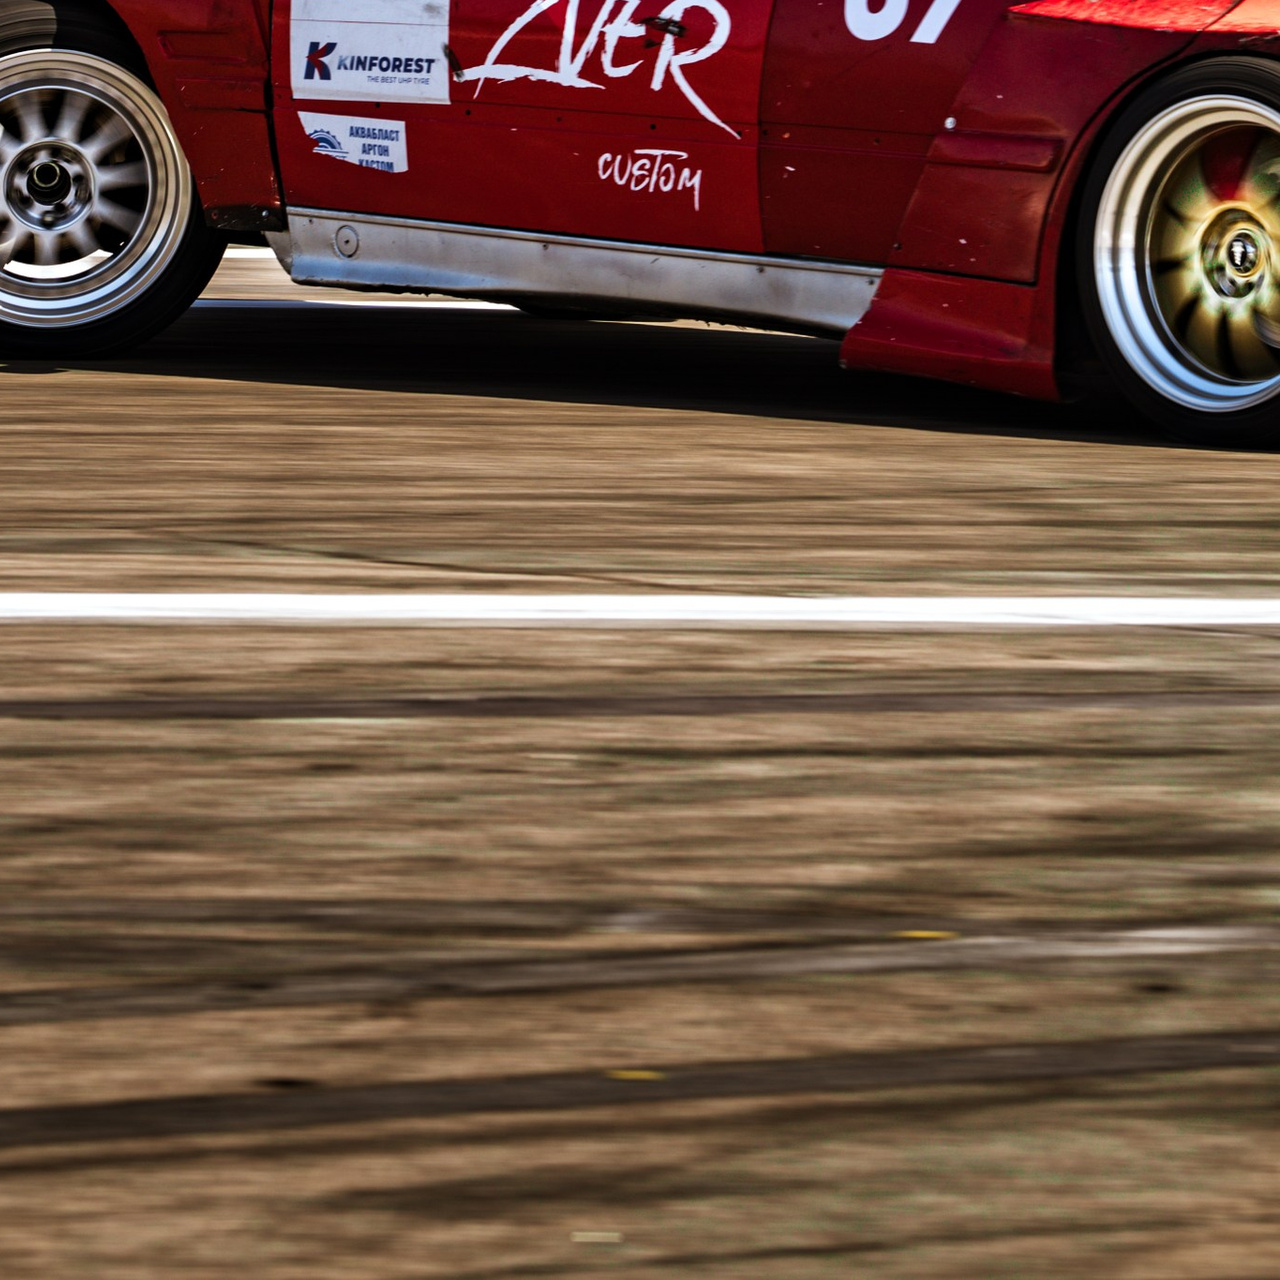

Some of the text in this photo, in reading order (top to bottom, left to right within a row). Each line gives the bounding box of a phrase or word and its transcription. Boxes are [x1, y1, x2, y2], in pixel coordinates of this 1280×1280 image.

[337, 55, 435, 74] KINFOREST
[367, 75, 380, 83] THE
[381, 76, 397, 84] BEST
[349, 126, 400, 142] АКВАБЛАСТ
[362, 143, 389, 157] АРГОН
[598, 149, 702, 211] CUSTOM
